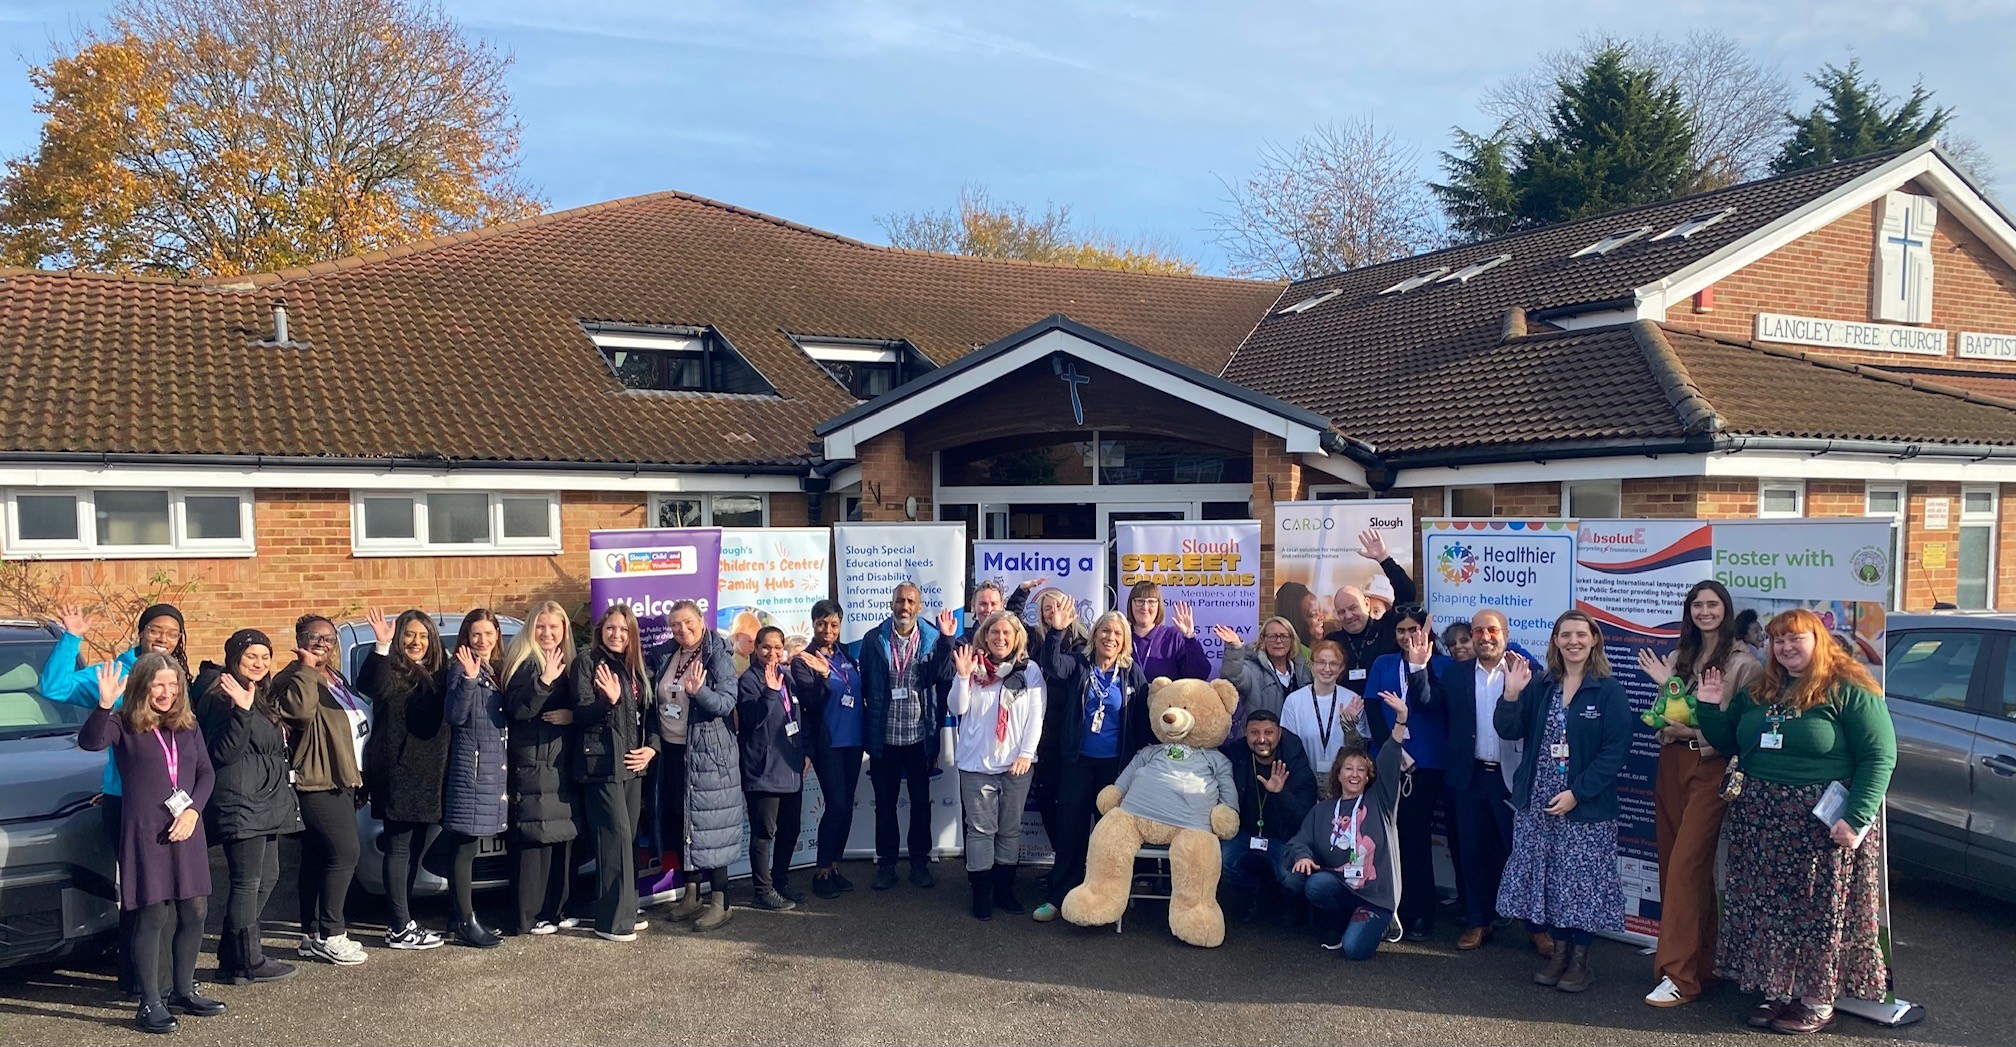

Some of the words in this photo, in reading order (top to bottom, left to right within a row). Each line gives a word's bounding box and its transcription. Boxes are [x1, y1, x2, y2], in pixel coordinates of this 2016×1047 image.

[1762, 317, 1833, 342] LANGLEY
[1845, 325, 1880, 346] FREE
[1890, 329, 1942, 351] CHURCH
[1282, 517, 1335, 531] CARDO
[1369, 517, 1403, 530] Slough
[846, 545, 878, 556] Slough
[882, 545, 915, 557] Special
[1182, 538, 1239, 558] Slough
[1484, 546, 1556, 564] Healthier
[1715, 549, 1779, 566] Foster
[1785, 549, 1834, 567] with
[779, 557, 826, 572] Centre/
[846, 559, 902, 568] Educational
[905, 558, 934, 568] Needs
[984, 551, 1071, 577] Making
[1078, 557, 1093, 571] a
[1121, 553, 1242, 572] STREET
[847, 573, 864, 581] and
[867, 572, 912, 582] Disability
[1121, 573, 1255, 587] GUARDIANS
[1483, 565, 1537, 588] Slough
[1593, 578, 1614, 586] leading
[1616, 579, 1654, 587] International
[1656, 580, 1684, 588] language
[1715, 570, 1786, 593] Slough
[764, 577, 795, 591] Hubs
[847, 585, 893, 595] Informati
[1181, 590, 1225, 598] Members
[1227, 590, 1236, 598] of
[1240, 590, 1255, 598] the
[1610, 587, 1629, 595] Sector
[1630, 589, 1656, 597] providing
[795, 596, 804, 604] to
[847, 601, 865, 609] and
[868, 600, 891, 610] Supp
[1198, 599, 1255, 608] Partnership
[1431, 592, 1476, 606] Shaping
[1480, 593, 1533, 606] healthier
[1584, 595, 1620, 603] professional
[1646, 607, 1673, 615] services
[1508, 617, 1554, 630] togethe
